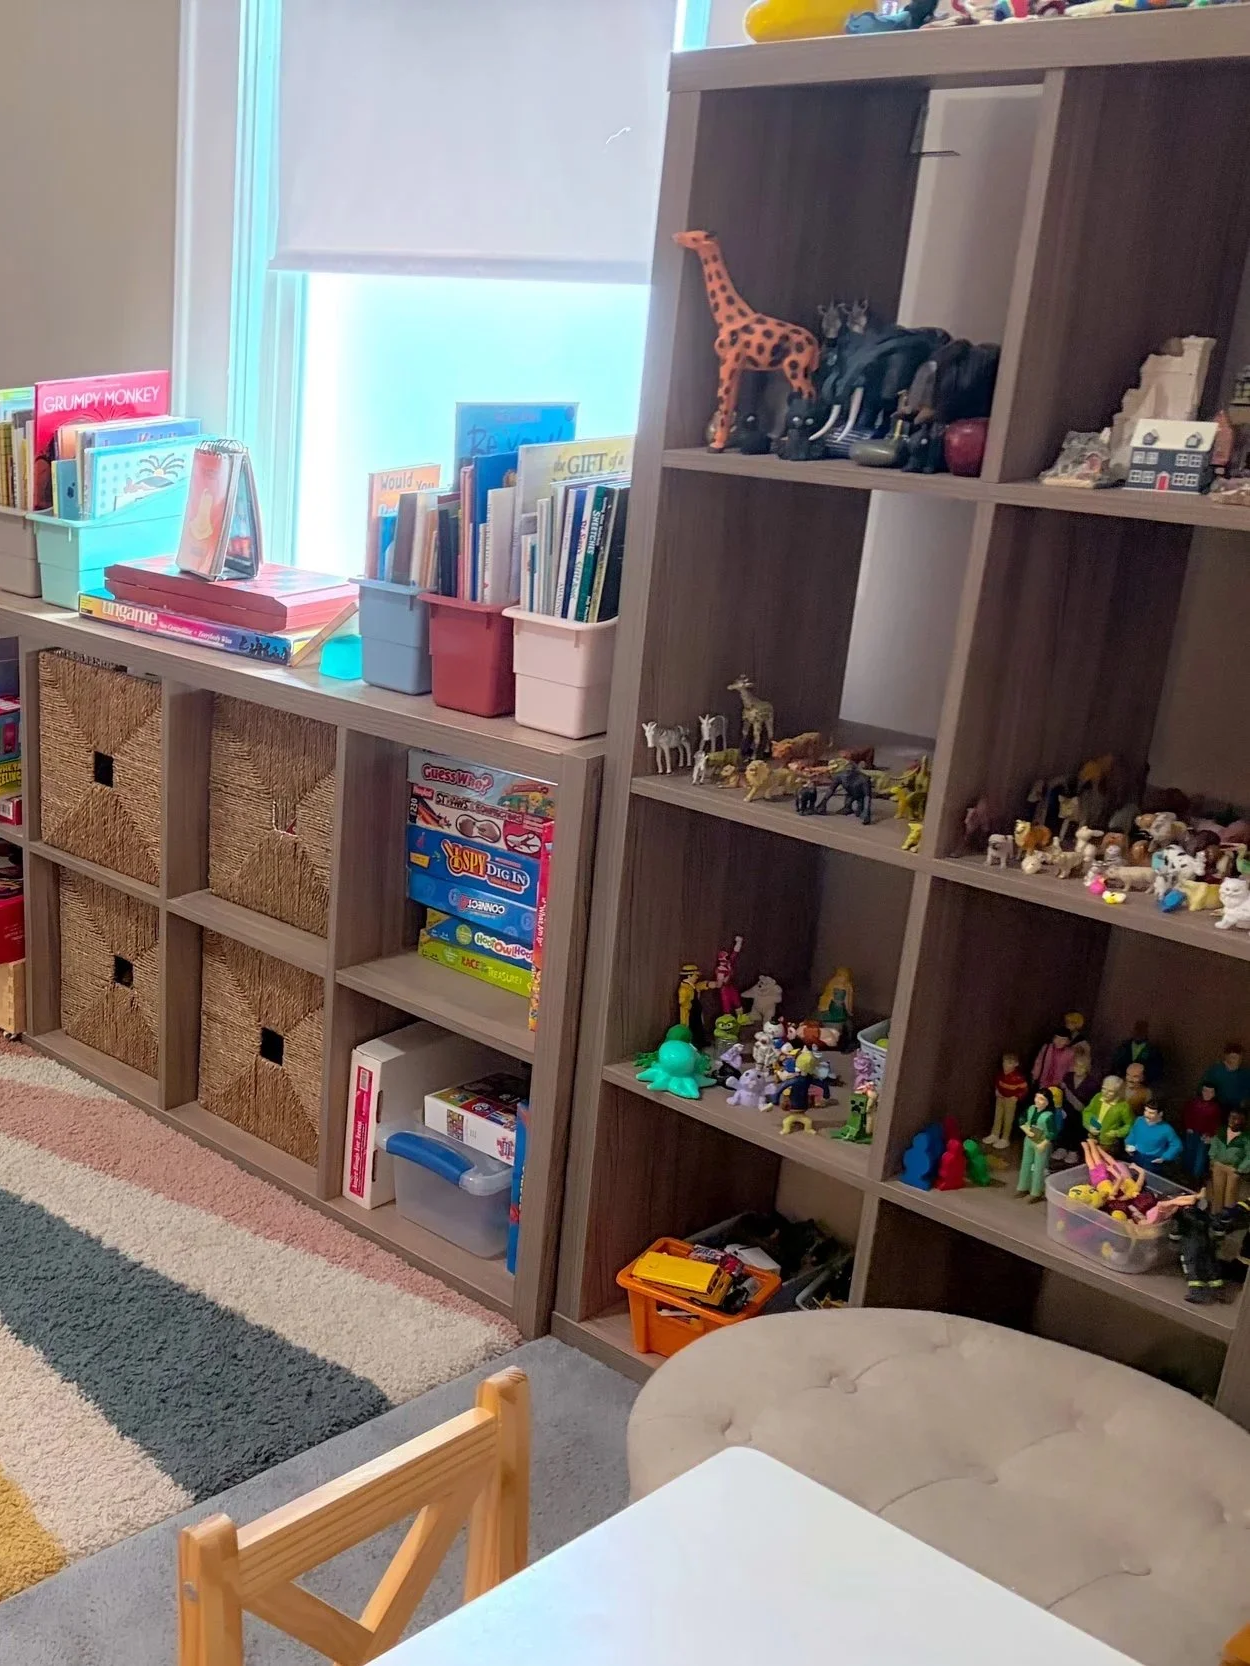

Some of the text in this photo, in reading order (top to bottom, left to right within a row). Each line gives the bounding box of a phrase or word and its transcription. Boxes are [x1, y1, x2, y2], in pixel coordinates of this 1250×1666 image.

[42, 386, 160, 413] GRUMPY MONKEY
[567, 453, 608, 475] GIFT
[381, 471, 414, 489] Would
[462, 848, 488, 877] SPY
[511, 871, 526, 885] IN
[468, 899, 505, 914] CONNECT
[461, 956, 479, 969] RACE
